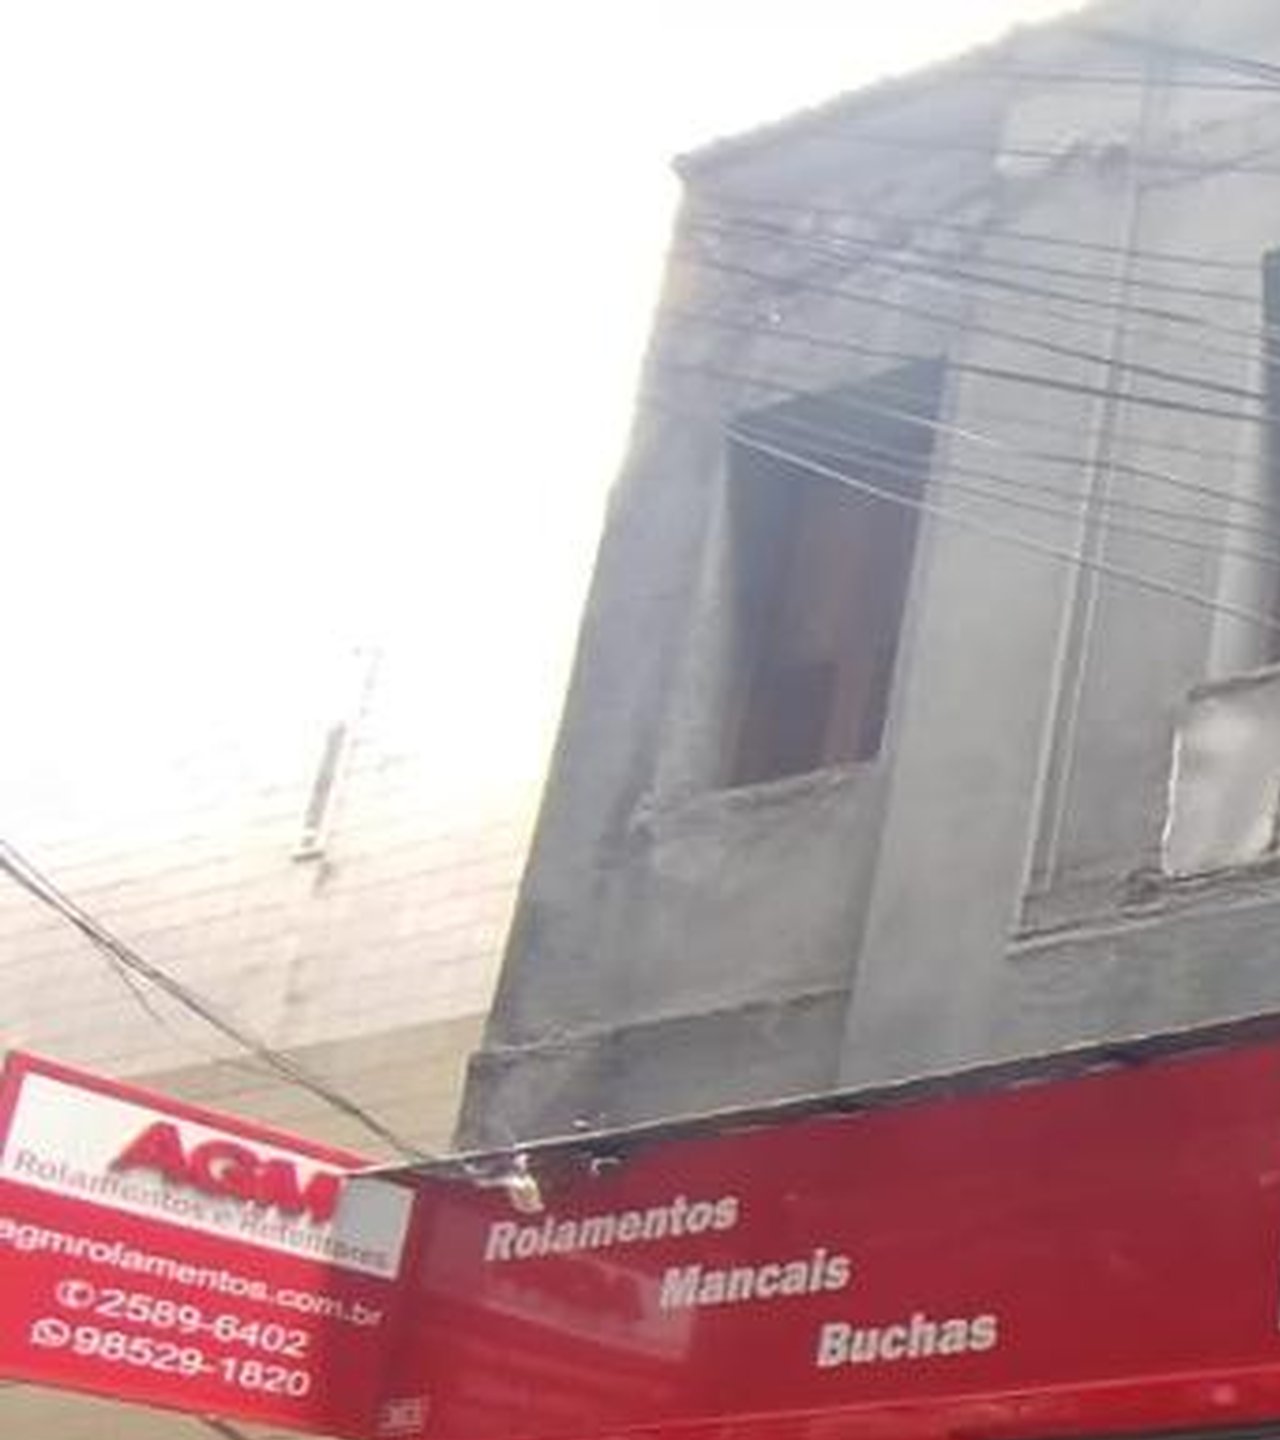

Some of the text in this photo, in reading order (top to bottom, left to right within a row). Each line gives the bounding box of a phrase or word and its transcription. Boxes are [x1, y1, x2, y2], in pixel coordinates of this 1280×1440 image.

[108, 1120, 345, 1226] AGM
[485, 1194, 740, 1261] Rolamentos
[659, 1248, 852, 1312] Mancais
[95, 1287, 310, 1358] 2589-6402
[816, 1313, 998, 1367] Buchas
